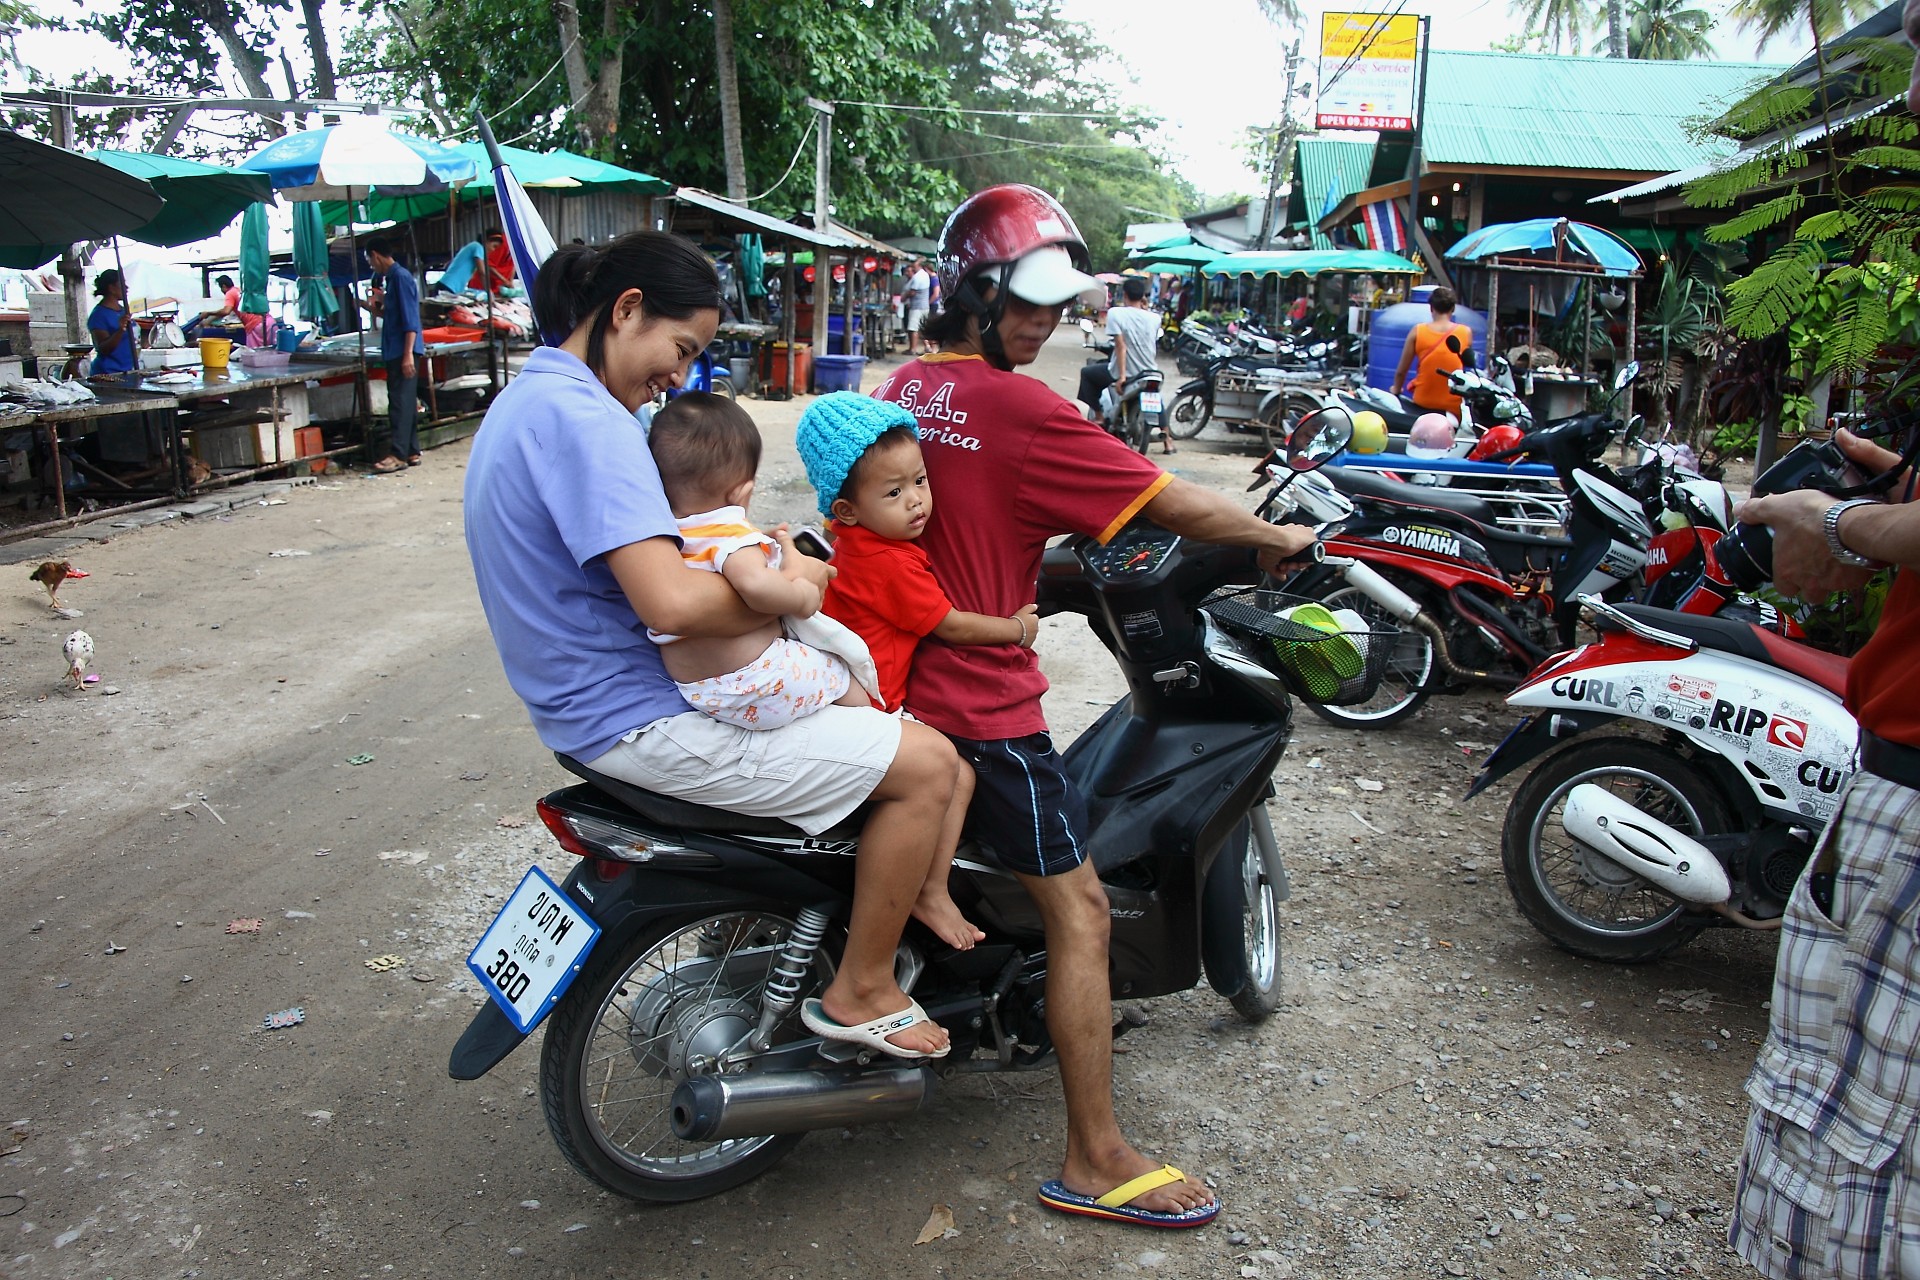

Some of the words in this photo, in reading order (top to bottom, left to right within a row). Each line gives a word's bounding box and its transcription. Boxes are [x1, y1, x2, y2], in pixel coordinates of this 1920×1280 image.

[1323, 61, 1367, 74] Cong
[1372, 62, 1411, 73] Service
[1320, 115, 1345, 126] OPEN
[1346, 116, 1407, 129] 09.30-21.00
[919, 426, 982, 451] erica
[1400, 528, 1460, 557] YAMAHA
[1611, 549, 1637, 565] HONDA
[1551, 676, 1618, 708] CURL
[1709, 699, 1768, 737] RIP
[576, 881, 594, 903] HONDA
[513, 934, 541, 964] ภูเก็ต
[486, 948, 531, 1004] 380
